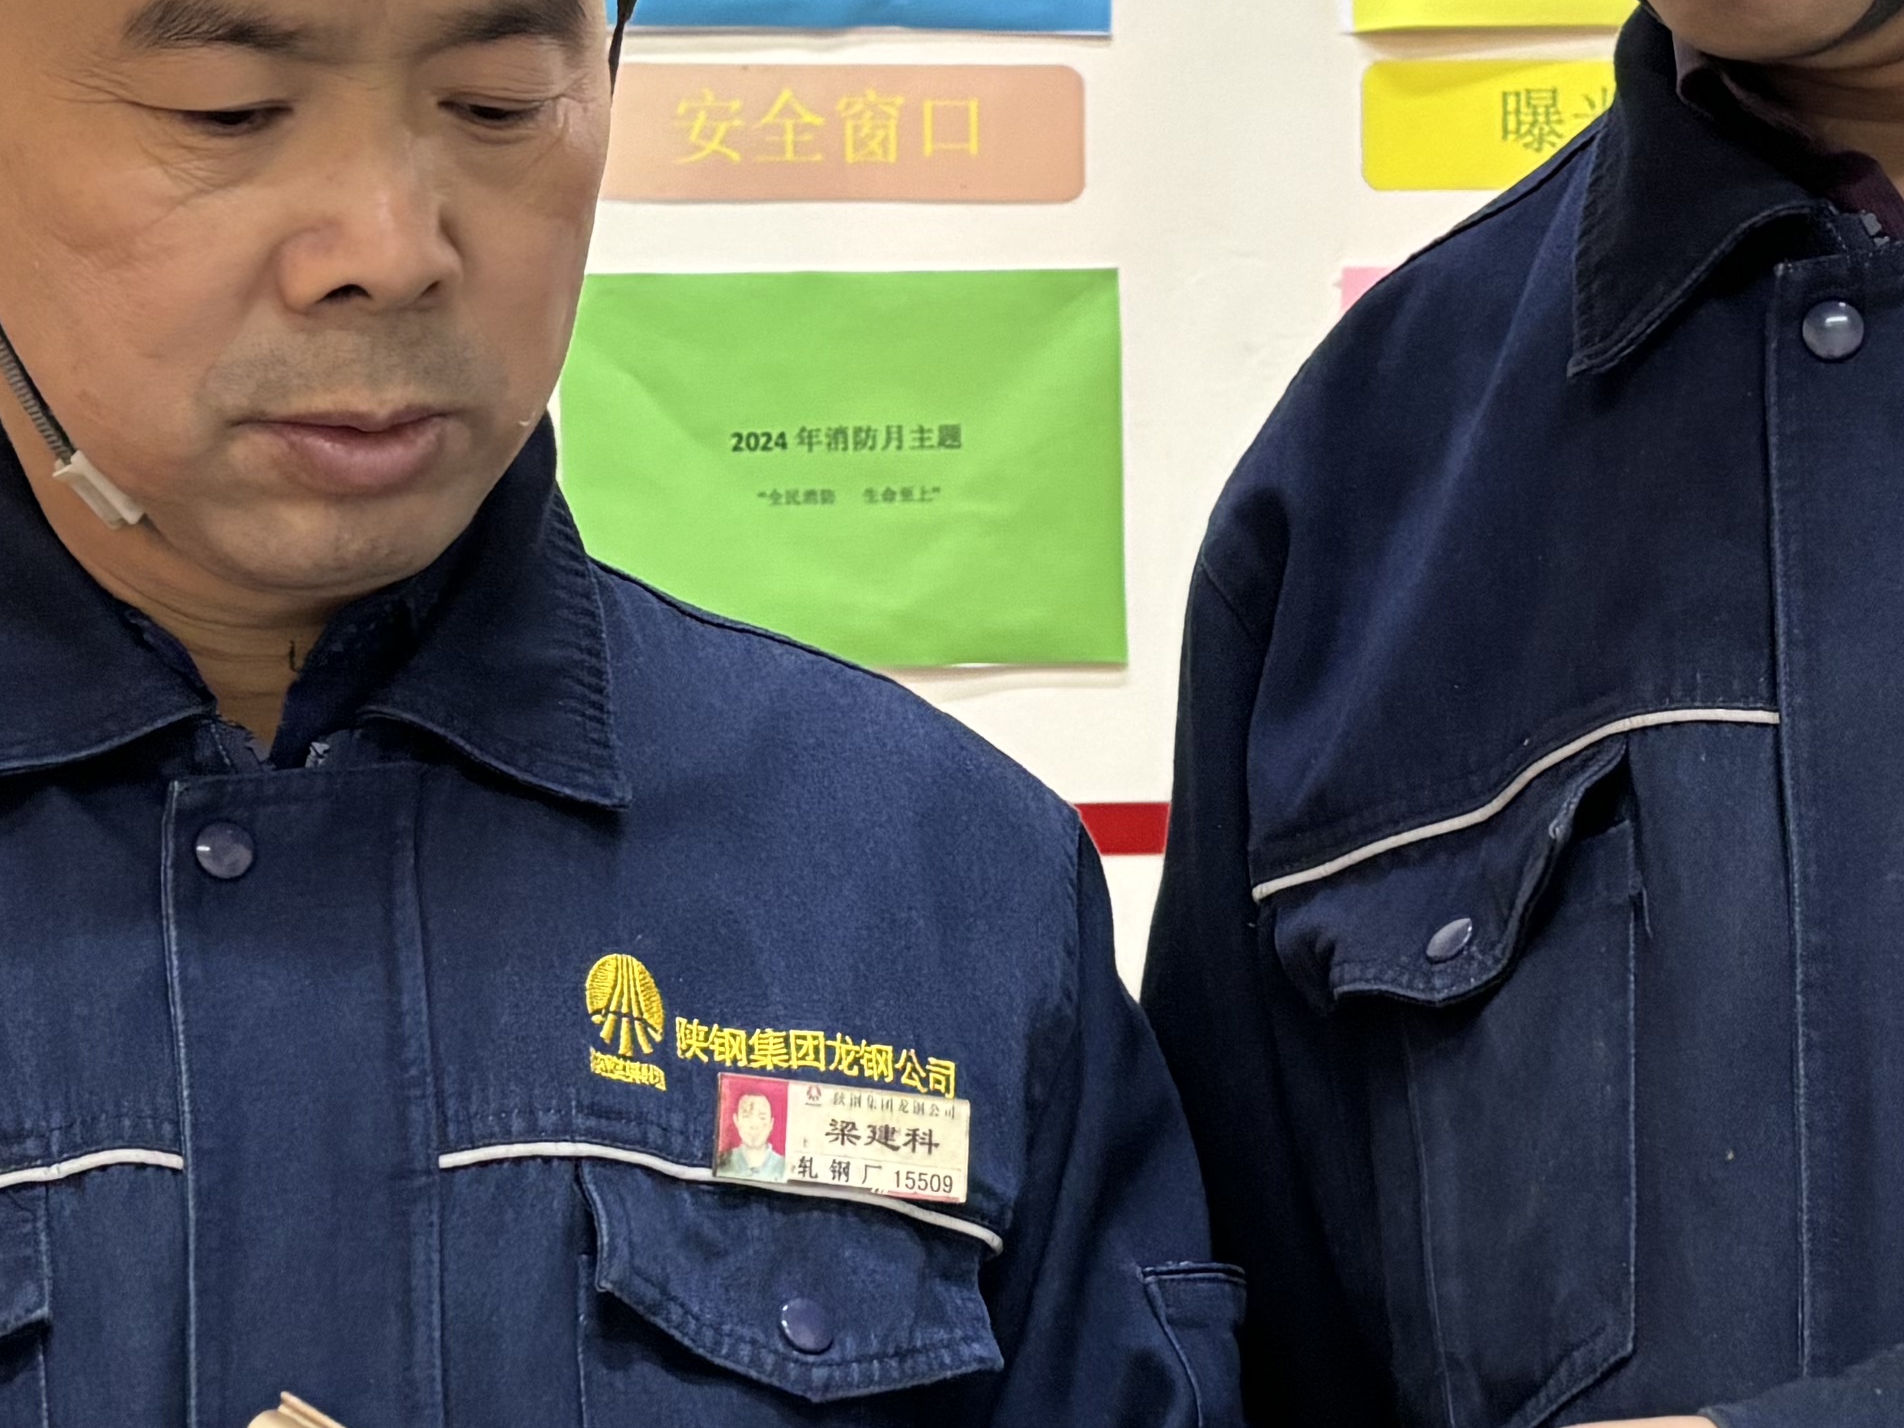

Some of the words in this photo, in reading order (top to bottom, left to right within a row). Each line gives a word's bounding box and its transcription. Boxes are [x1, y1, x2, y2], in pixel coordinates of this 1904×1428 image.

[673, 87, 982, 166] 安全窗口
[730, 431, 789, 453] 2024
[795, 424, 964, 453] 年消防月主题
[675, 1015, 957, 1099] 陕钢集团龙钢公司
[824, 1118, 940, 1156] 梁建科
[797, 1154, 883, 1185] 轧钢厂
[894, 1169, 954, 1194] 15509
